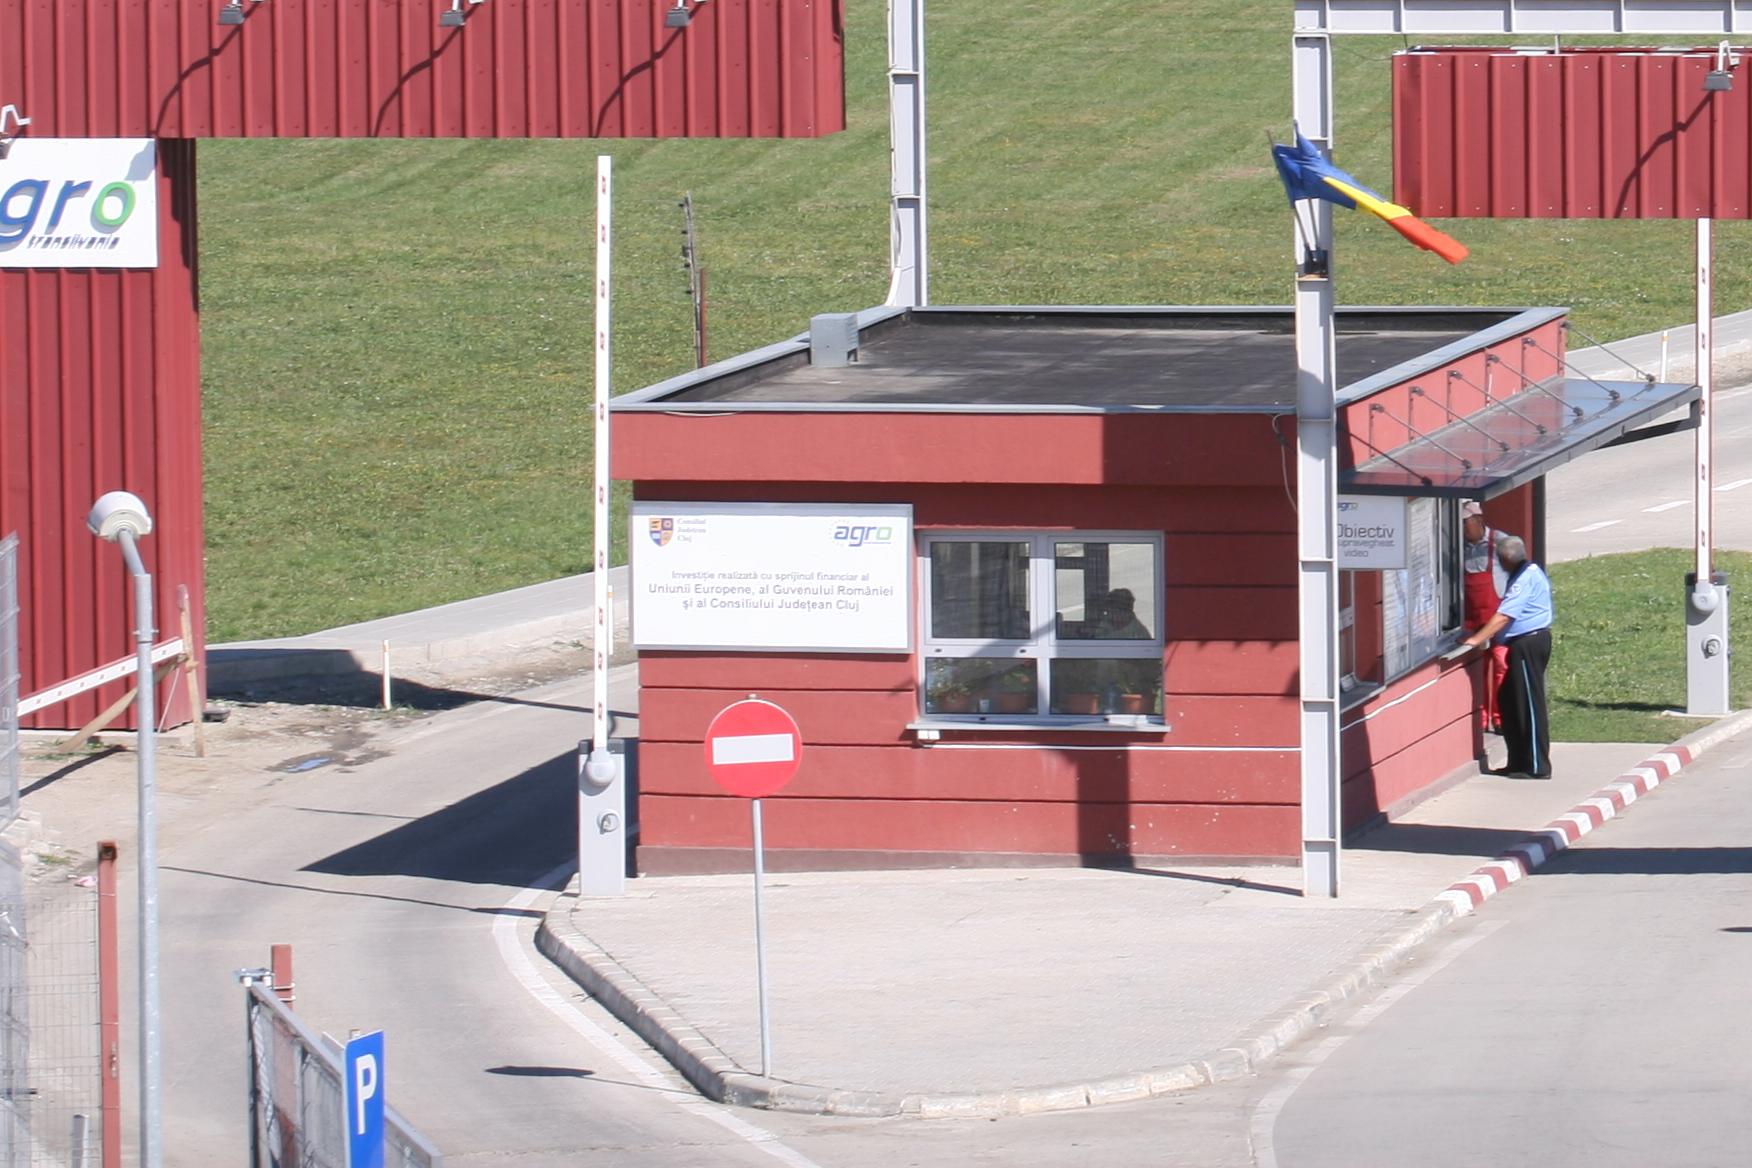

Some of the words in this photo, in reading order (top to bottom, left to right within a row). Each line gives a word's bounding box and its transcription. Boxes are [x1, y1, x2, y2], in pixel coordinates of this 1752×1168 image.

[0, 178, 136, 244] gro
[834, 525, 892, 547] agro
[648, 583, 691, 594] Uniunii
[694, 583, 755, 596] Europene,
[759, 584, 769, 594] al
[837, 585, 894, 597] României
[696, 598, 707, 608] al
[710, 598, 775, 609] Consiliului
[836, 600, 860, 612] Cluj
[356, 1053, 377, 1135] P
